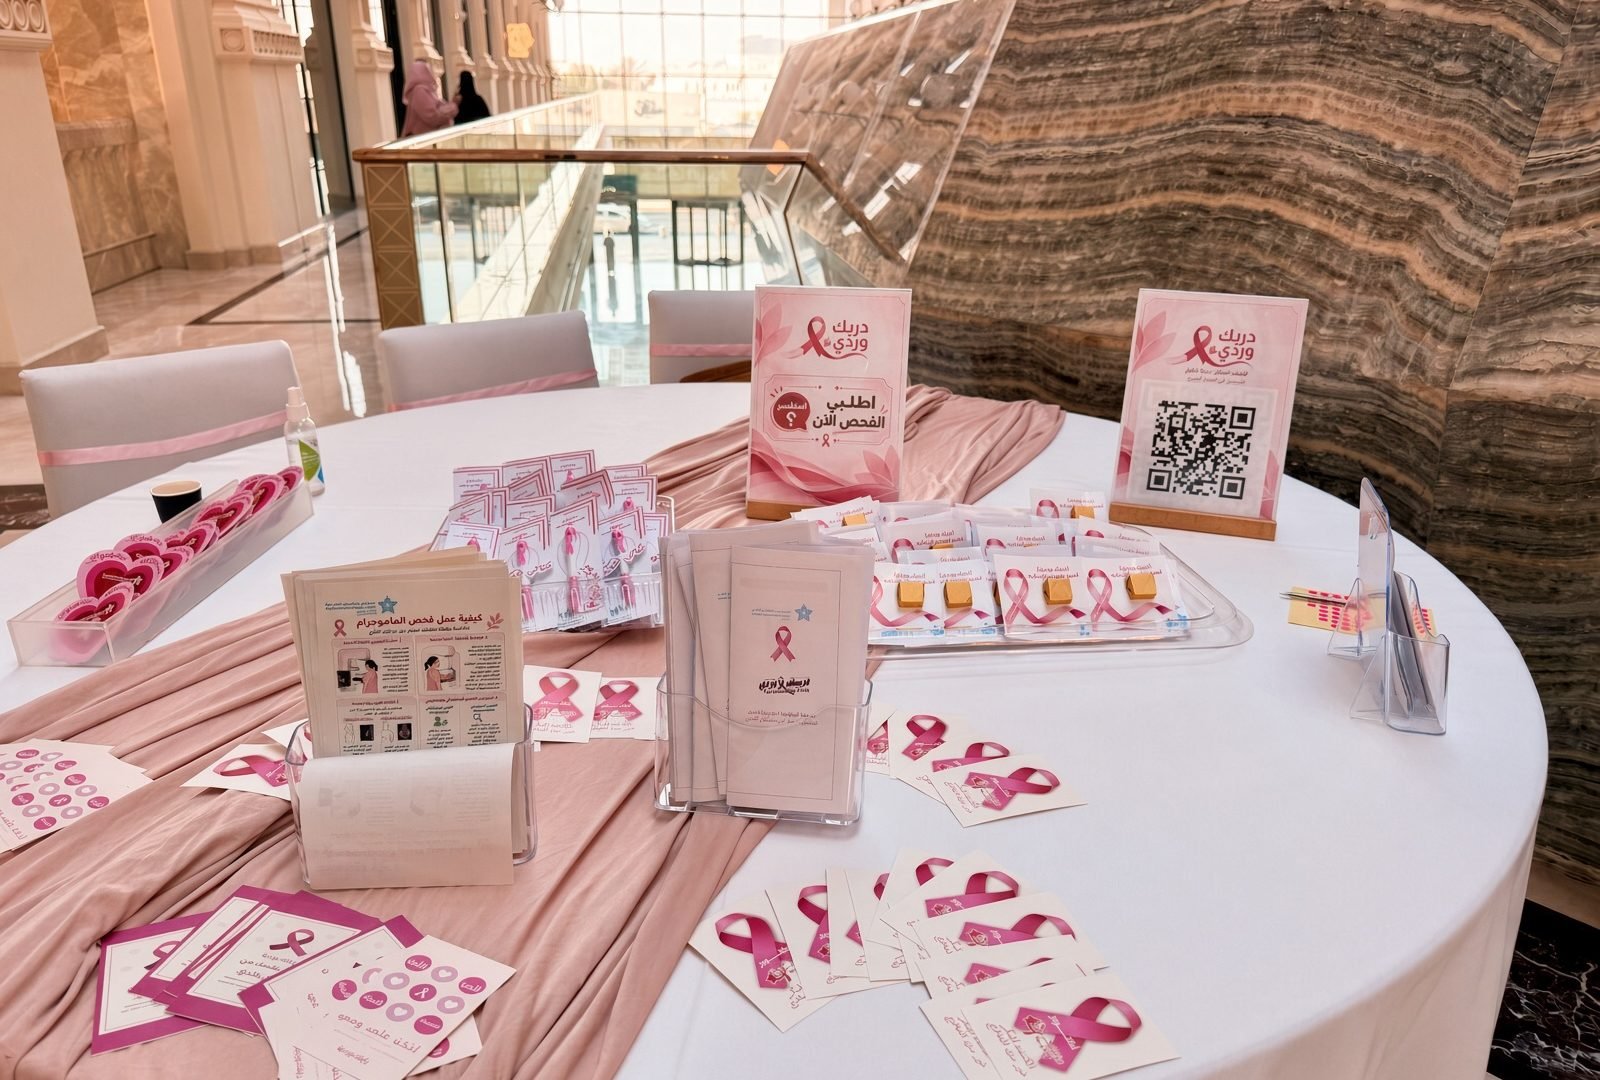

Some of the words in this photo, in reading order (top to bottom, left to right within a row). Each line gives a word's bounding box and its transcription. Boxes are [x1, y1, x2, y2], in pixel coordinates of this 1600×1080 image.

[833, 319, 869, 337] دربك
[833, 336, 869, 354] وردي
[1219, 329, 1256, 346] دربك
[1218, 345, 1254, 362] وردي
[826, 395, 876, 413] اطلبي
[839, 416, 886, 429] الفحص
[436, 614, 456, 625] عمل
